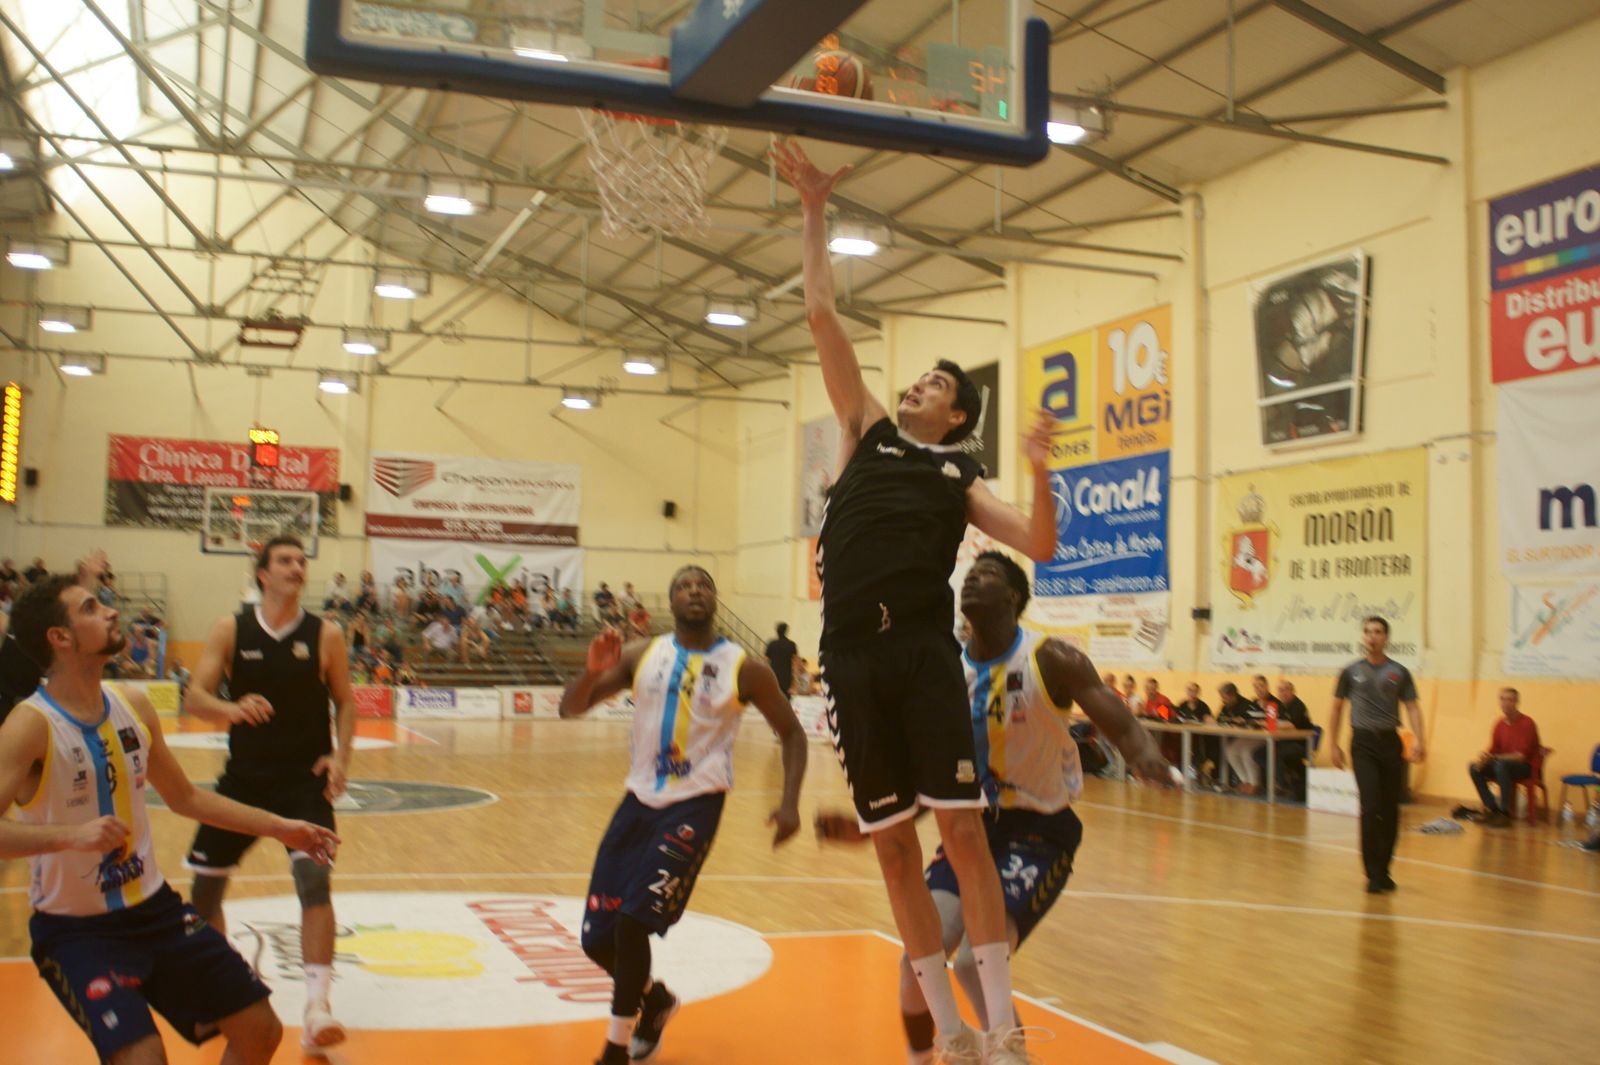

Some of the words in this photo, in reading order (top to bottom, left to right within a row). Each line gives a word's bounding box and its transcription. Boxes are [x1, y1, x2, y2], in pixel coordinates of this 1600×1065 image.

[1495, 189, 1600, 255] euro
[1524, 307, 1600, 371] eu
[1074, 466, 1162, 516] Canal4
[1539, 483, 1597, 530] m
[1335, 553, 1412, 579] FRONTERA
